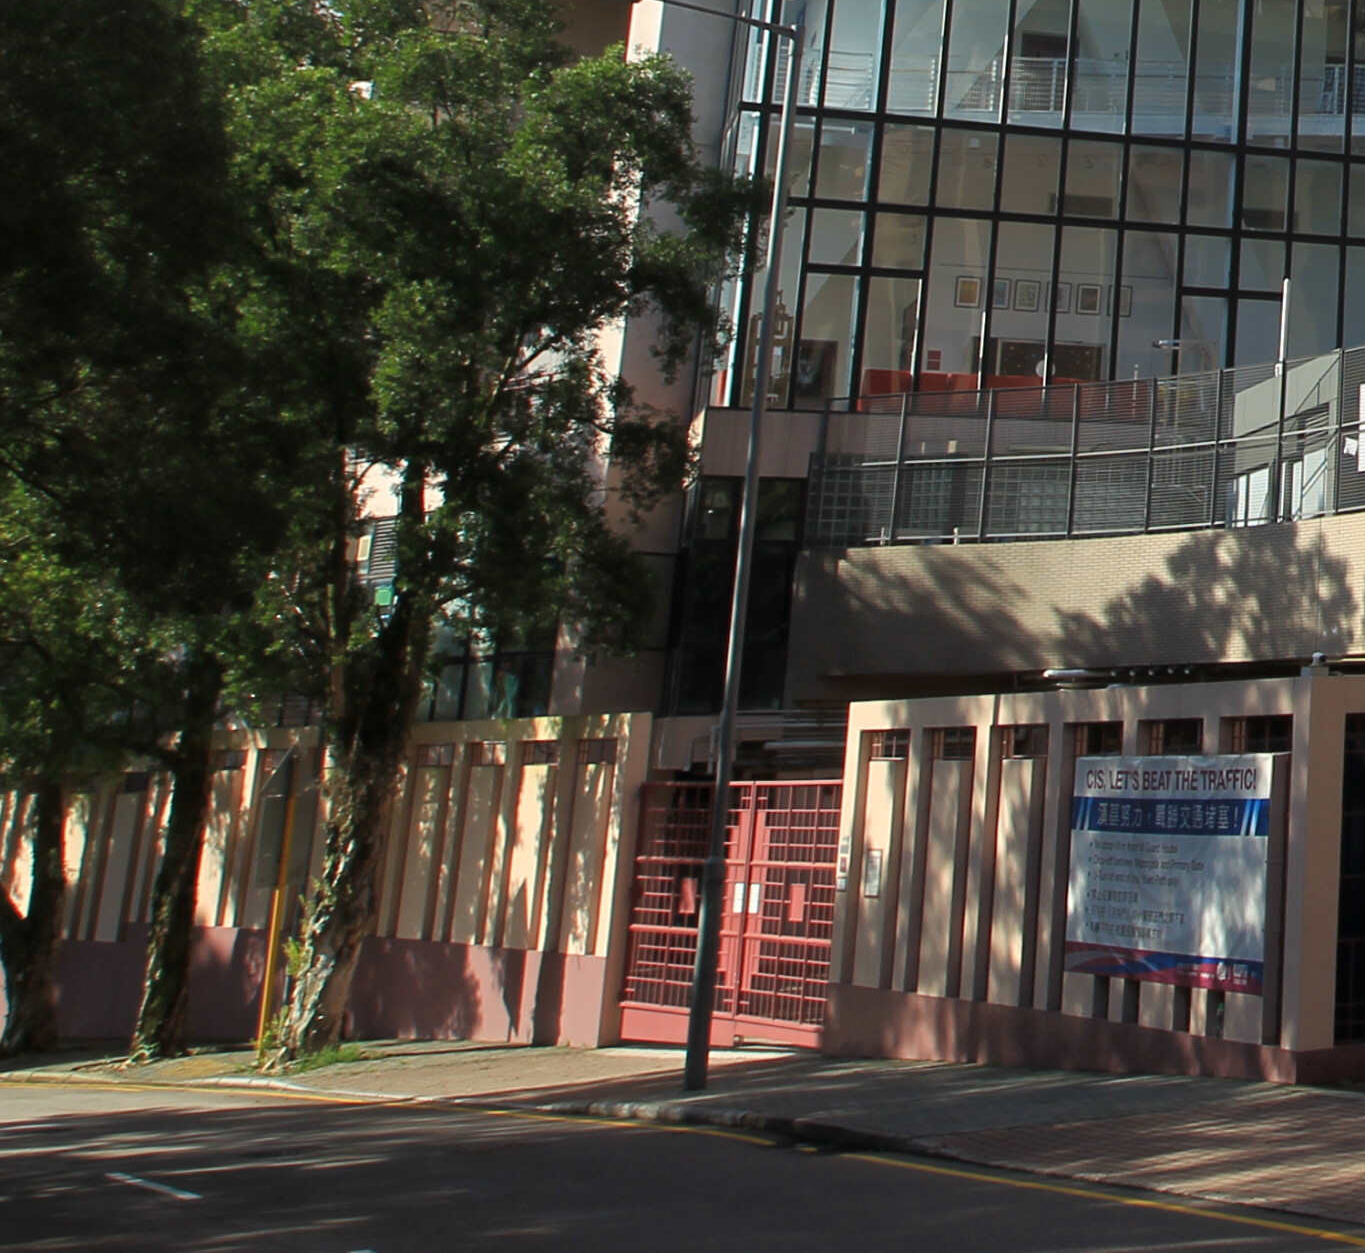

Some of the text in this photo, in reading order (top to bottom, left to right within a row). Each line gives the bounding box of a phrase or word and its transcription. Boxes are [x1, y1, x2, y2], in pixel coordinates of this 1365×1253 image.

[1086, 768, 1257, 791] CIS, LET'S BEAT THE TRAFFIC!
